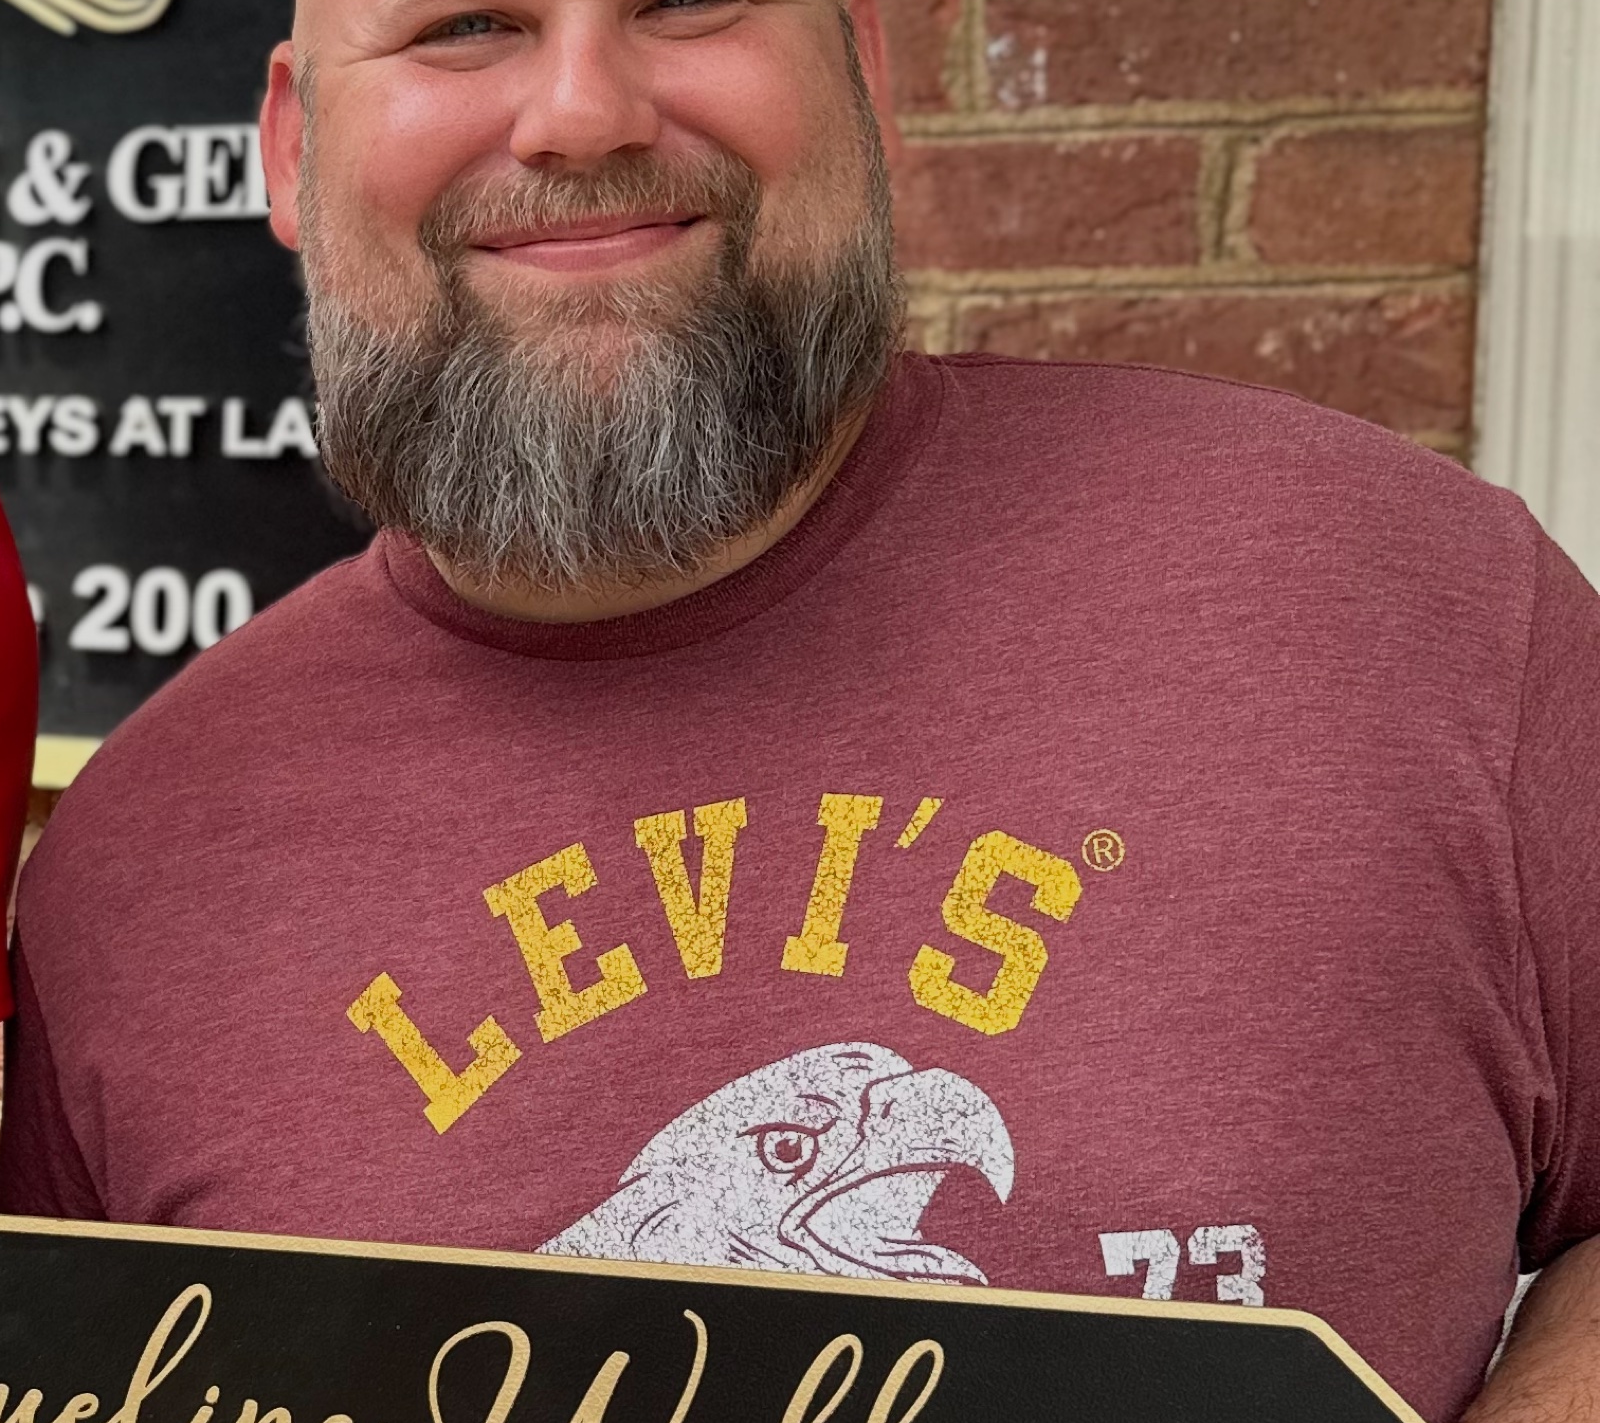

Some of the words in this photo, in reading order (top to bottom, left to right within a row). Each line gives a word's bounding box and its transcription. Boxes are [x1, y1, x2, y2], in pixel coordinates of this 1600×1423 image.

[6, 129, 94, 226] &
[108, 395, 206, 457] AT
[221, 397, 320, 459] LA
[68, 563, 252, 655] 200
[1097, 1224, 1267, 1308] 73
